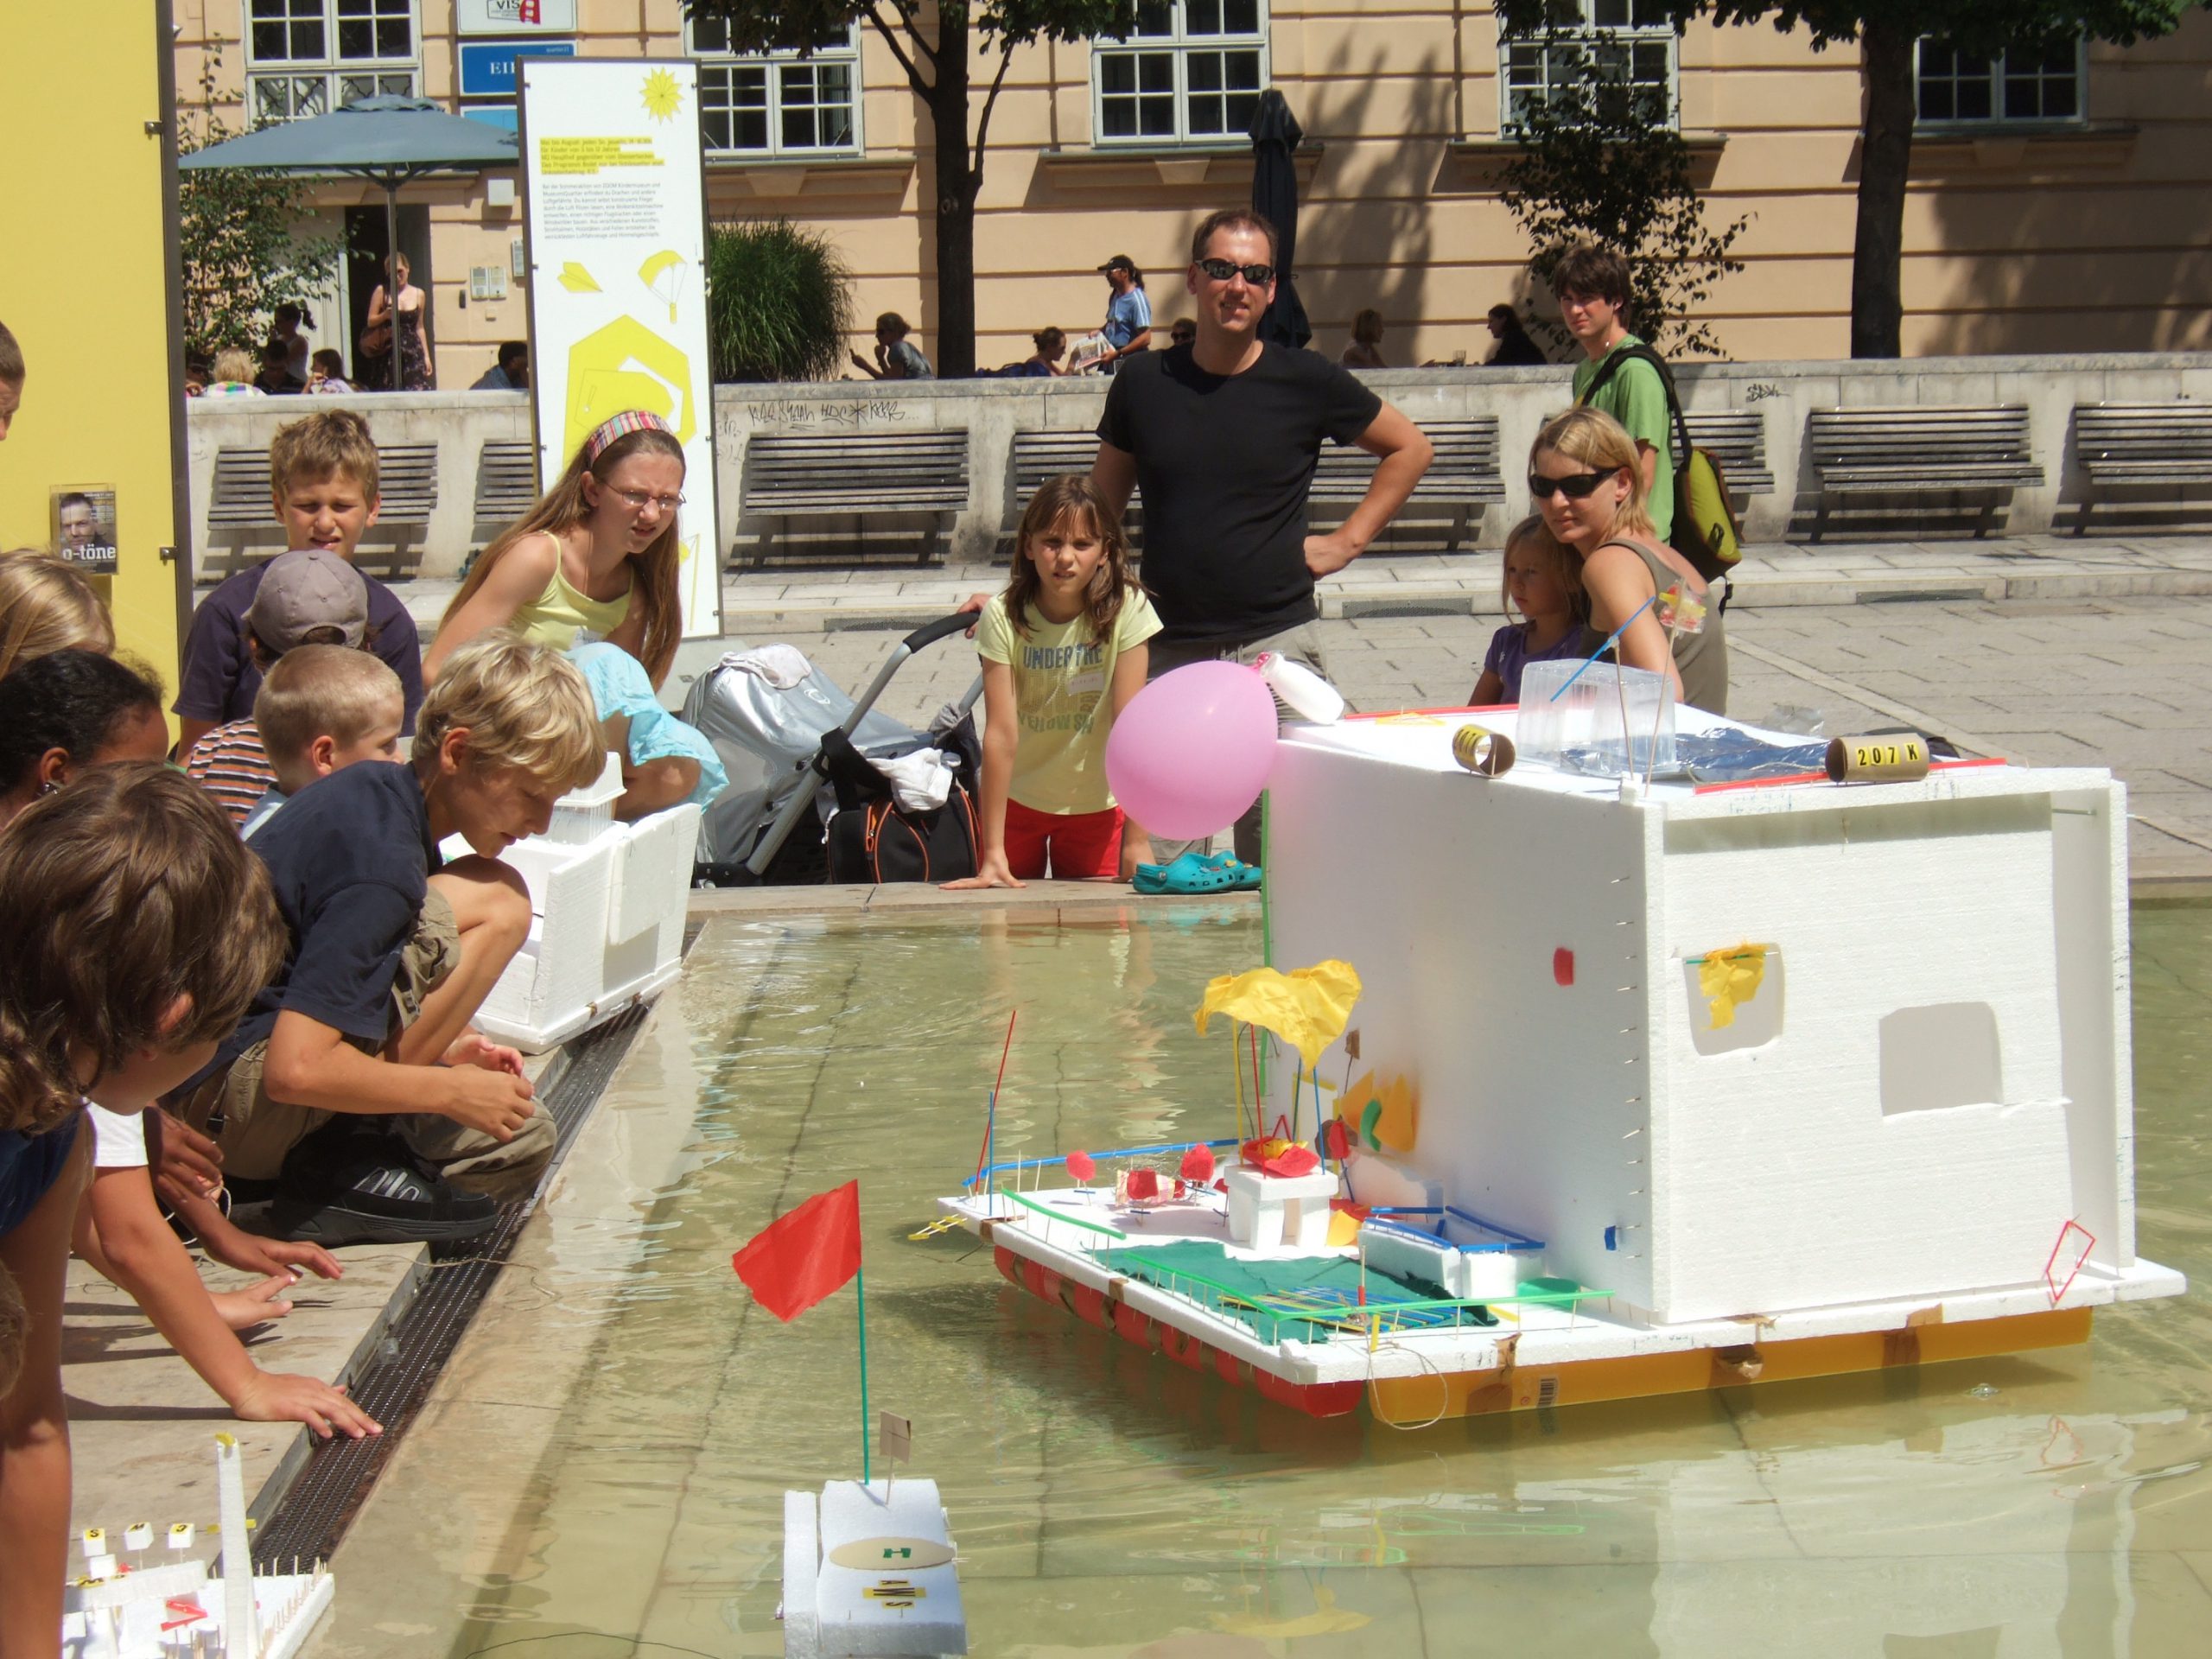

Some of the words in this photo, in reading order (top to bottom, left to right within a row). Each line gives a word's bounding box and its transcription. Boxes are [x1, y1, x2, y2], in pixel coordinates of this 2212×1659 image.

[62, 543, 117, 561] o-töne
[1023, 645, 1073, 669] UNDER
[1857, 746, 1897, 766] 207
[1906, 743, 1920, 762] K
